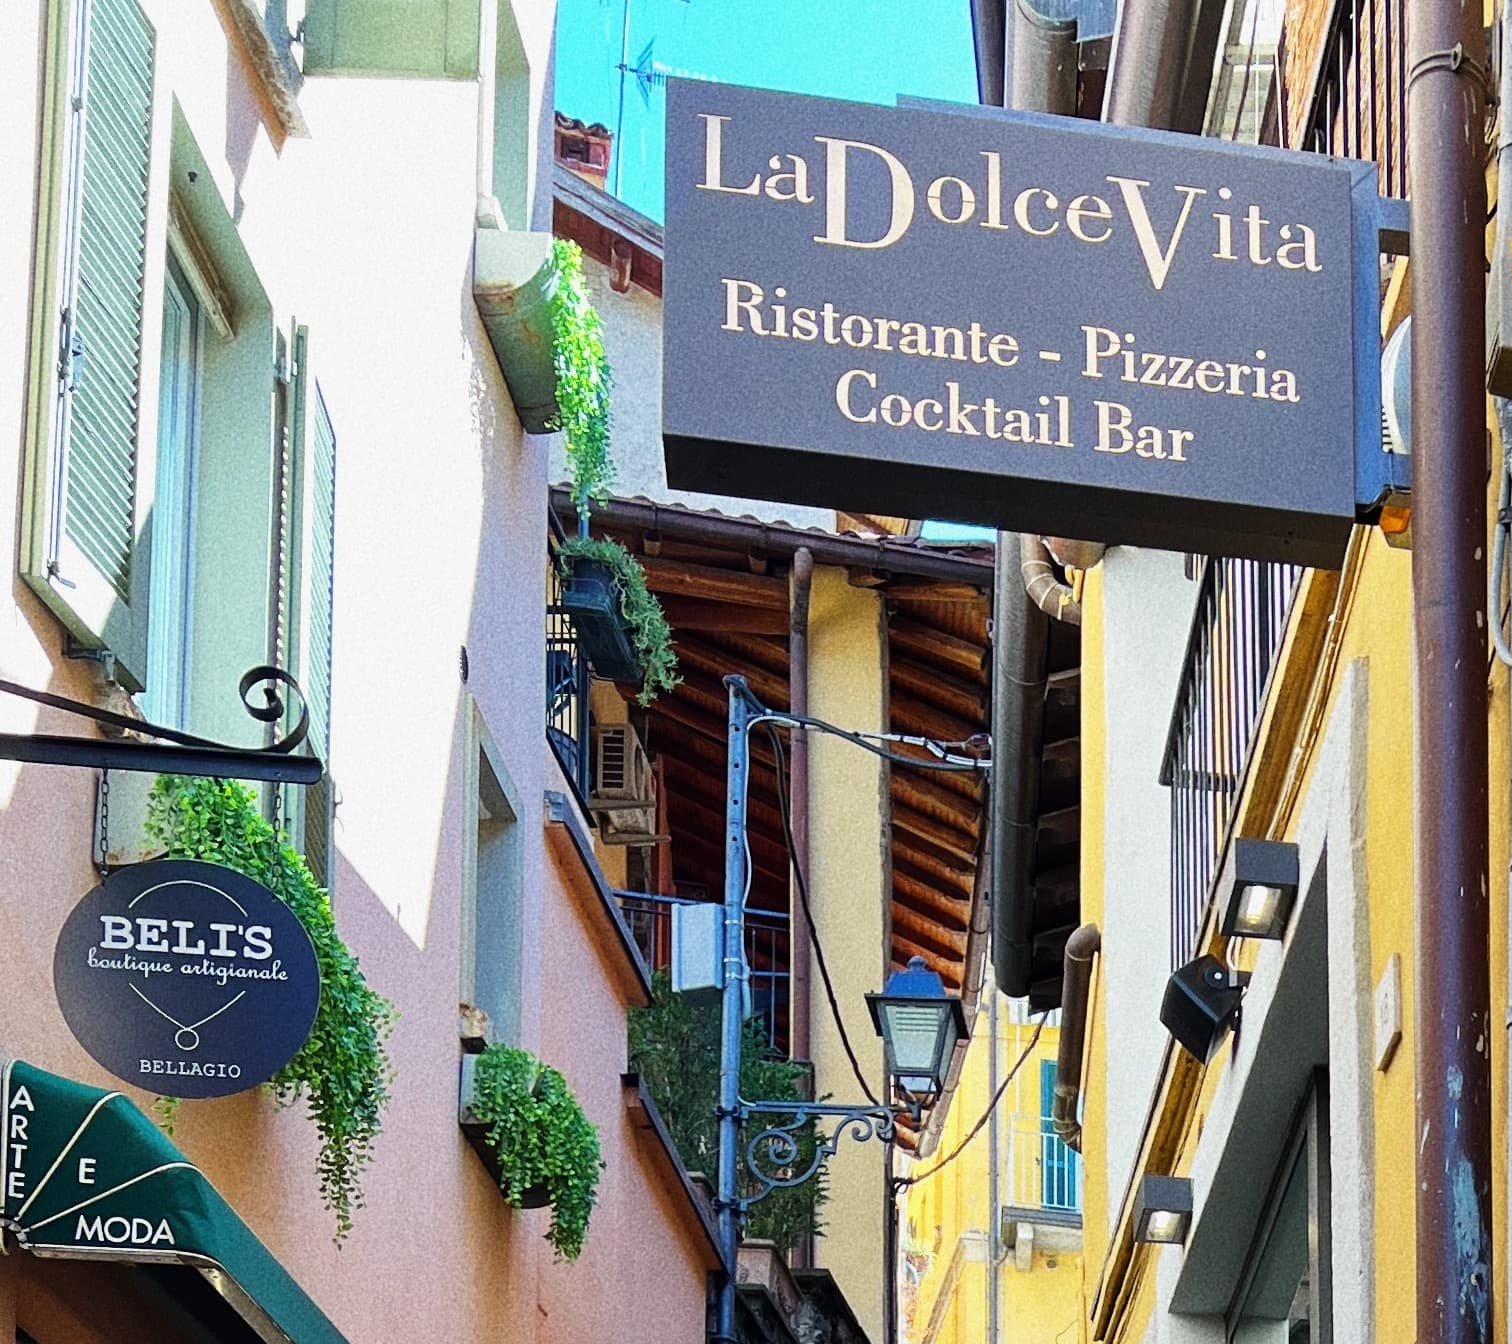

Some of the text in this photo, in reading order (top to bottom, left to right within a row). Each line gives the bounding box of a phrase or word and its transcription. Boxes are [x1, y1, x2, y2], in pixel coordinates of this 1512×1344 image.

[721, 278, 1019, 366] Ristorante
[1081, 325, 1300, 403] Pizzeria
[835, 369, 1194, 461] Cocktail Bar
[100, 915, 273, 960] BELI'S
[87, 946, 289, 985] boutique artigianale
[139, 1059, 241, 1079] BELLAGIO
[8, 1085, 35, 1199] ARTE
[78, 1158, 96, 1184] E
[75, 1214, 175, 1245] MODA
